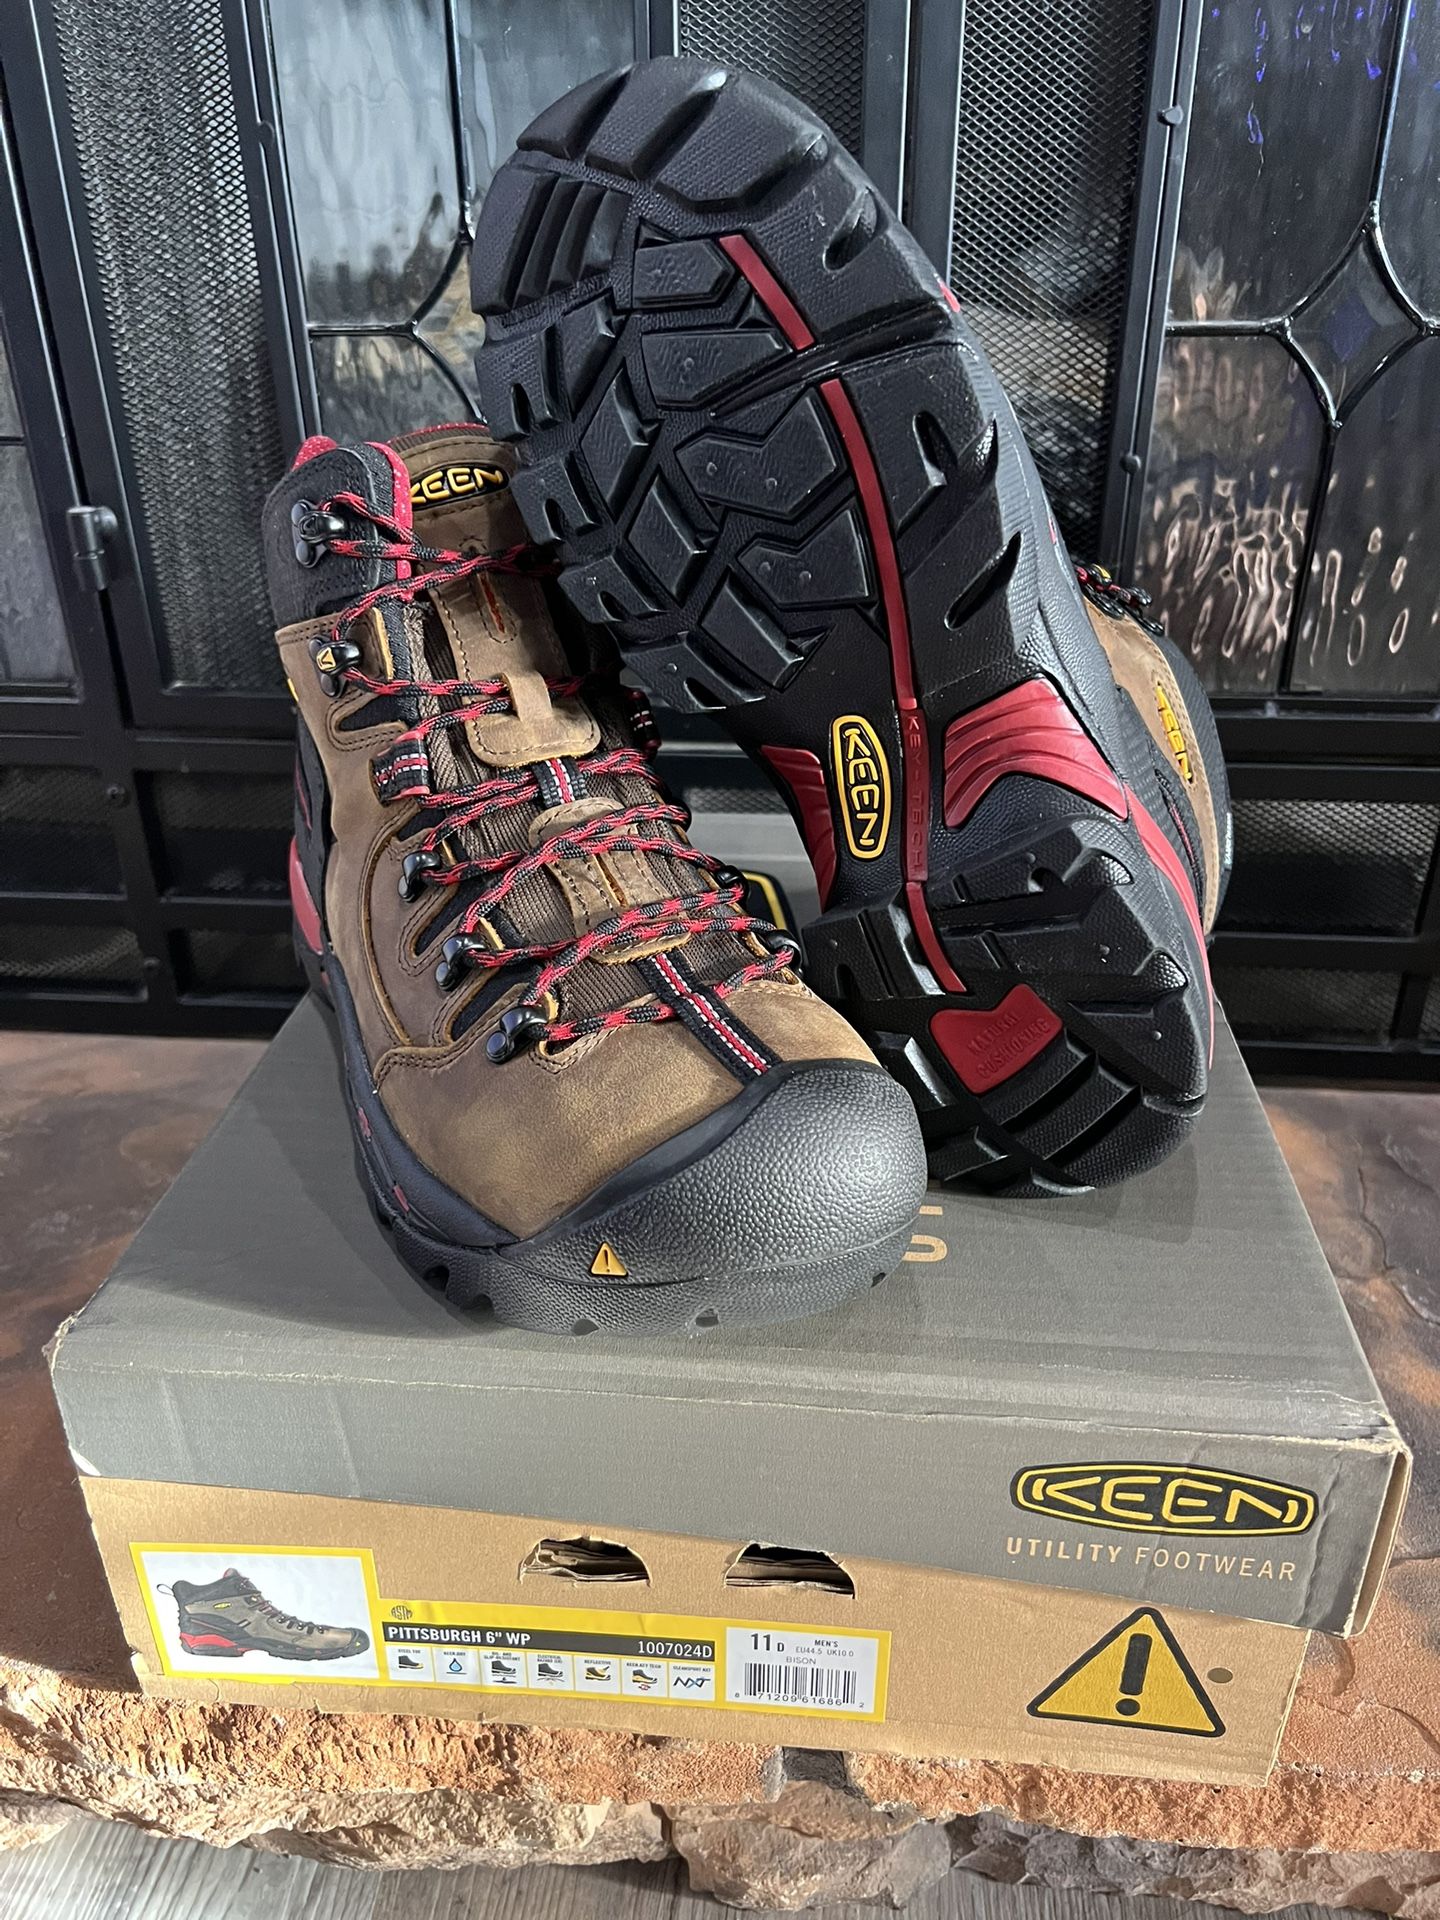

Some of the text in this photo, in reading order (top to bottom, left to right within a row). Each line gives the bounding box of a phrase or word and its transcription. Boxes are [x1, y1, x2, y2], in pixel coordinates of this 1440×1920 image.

[409, 467, 504, 504] KEEN
[842, 726, 881, 848] KEEN
[908, 714, 925, 873] KEY-TECH
[968, 1010, 1021, 1056] NATURAL
[976, 1018, 1050, 1078] CUSHIONING
[1030, 1474, 1300, 1526] KEEN
[1007, 1536, 1297, 1582] UTILITY FOOTWEAR
[387, 1626, 482, 1644] PITTSBURGH
[505, 1632, 531, 1646] WP
[638, 1640, 713, 1658] 1007024D
[750, 1632, 785, 1652] 11 D
[785, 1655, 817, 1665] BISON
[814, 1639, 839, 1648] MEN'S
[757, 1692, 798, 1703] 71209
[801, 1696, 842, 1706] 61686
